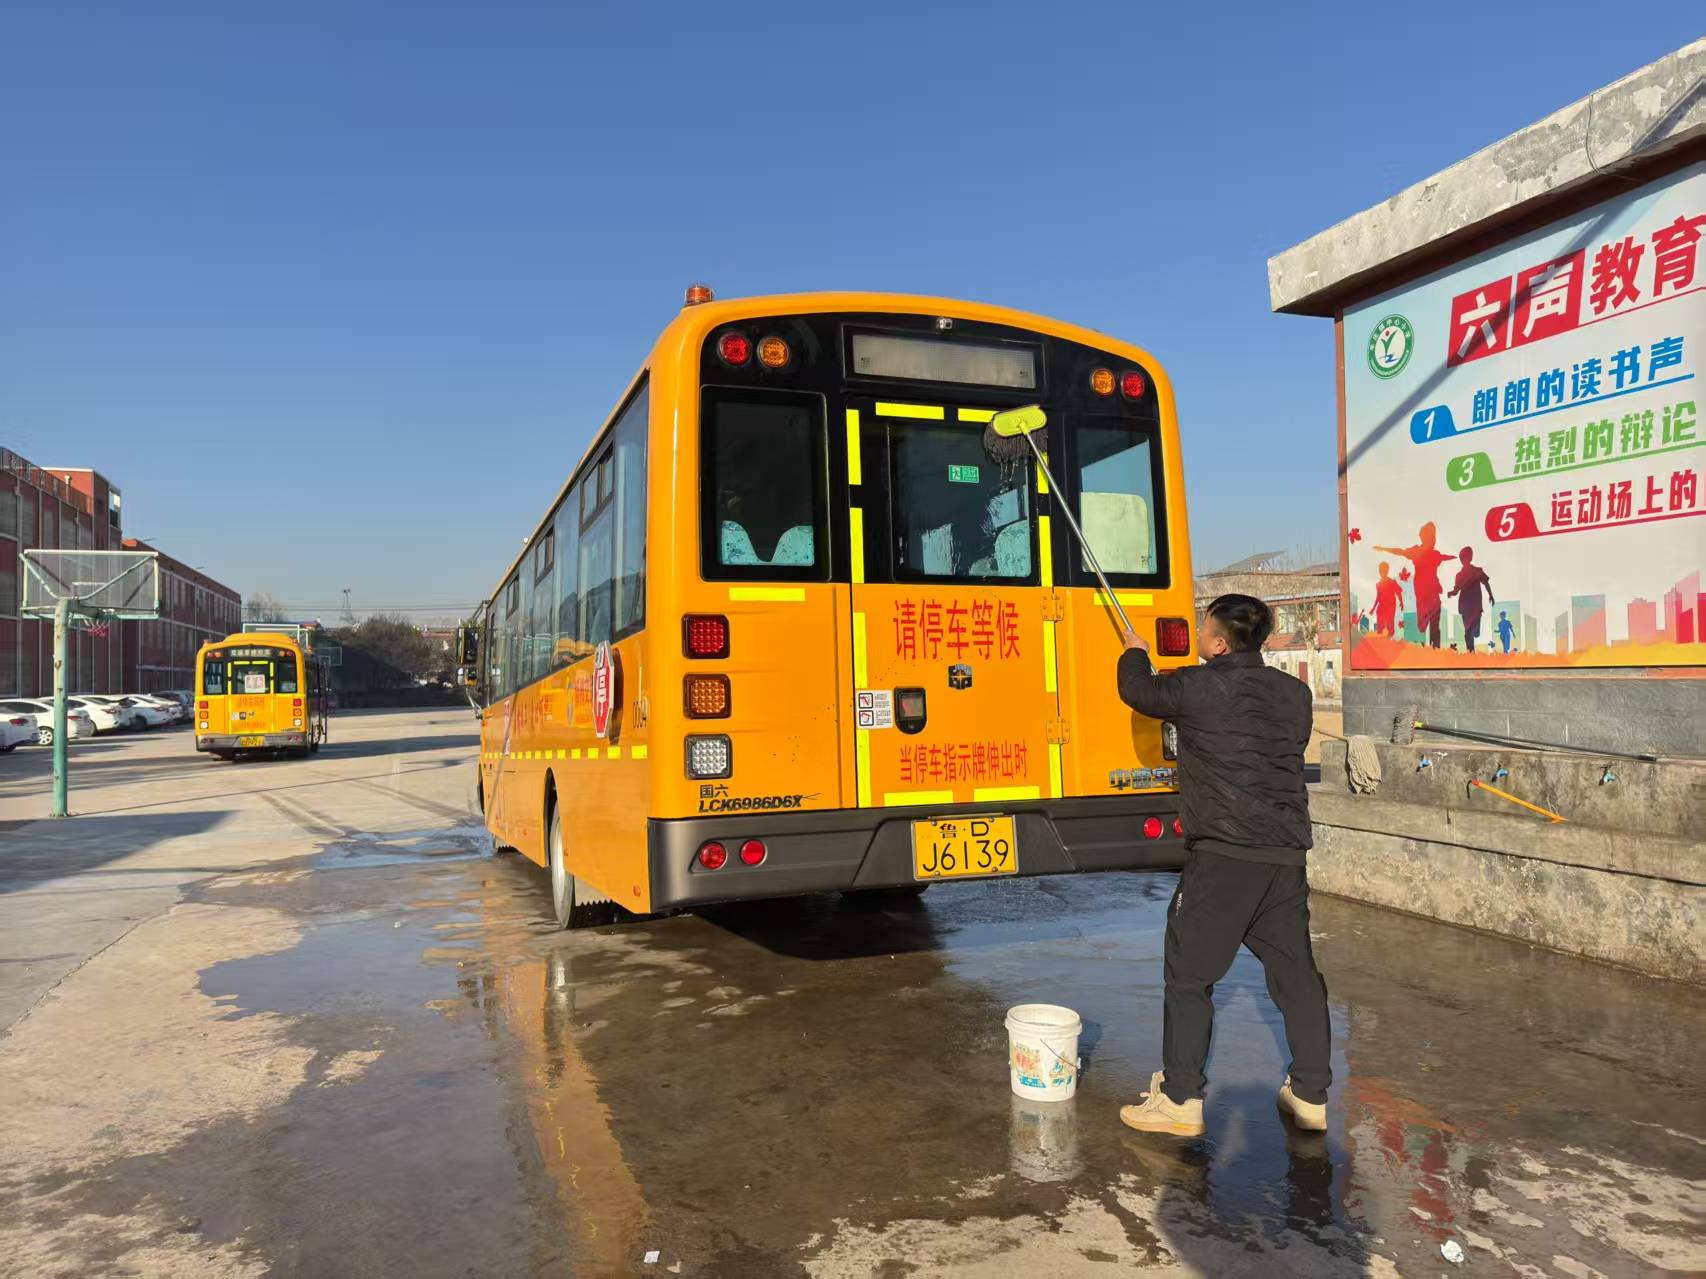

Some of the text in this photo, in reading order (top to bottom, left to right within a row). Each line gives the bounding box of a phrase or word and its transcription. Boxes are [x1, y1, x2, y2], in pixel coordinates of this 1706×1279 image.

[1457, 214, 1706, 359] 六声教育
[1423, 411, 1436, 439] 1
[1472, 336, 1685, 425] 朗朗的读书声
[1458, 401, 1697, 487] 3 热烈的辩论
[1499, 469, 1697, 537] 5 运动场上的
[893, 598, 1020, 660] 请停车等候
[700, 784, 728, 798] 国六
[900, 738, 1028, 784] 当停车指示牌伸出时
[922, 839, 1009, 872] J6139
